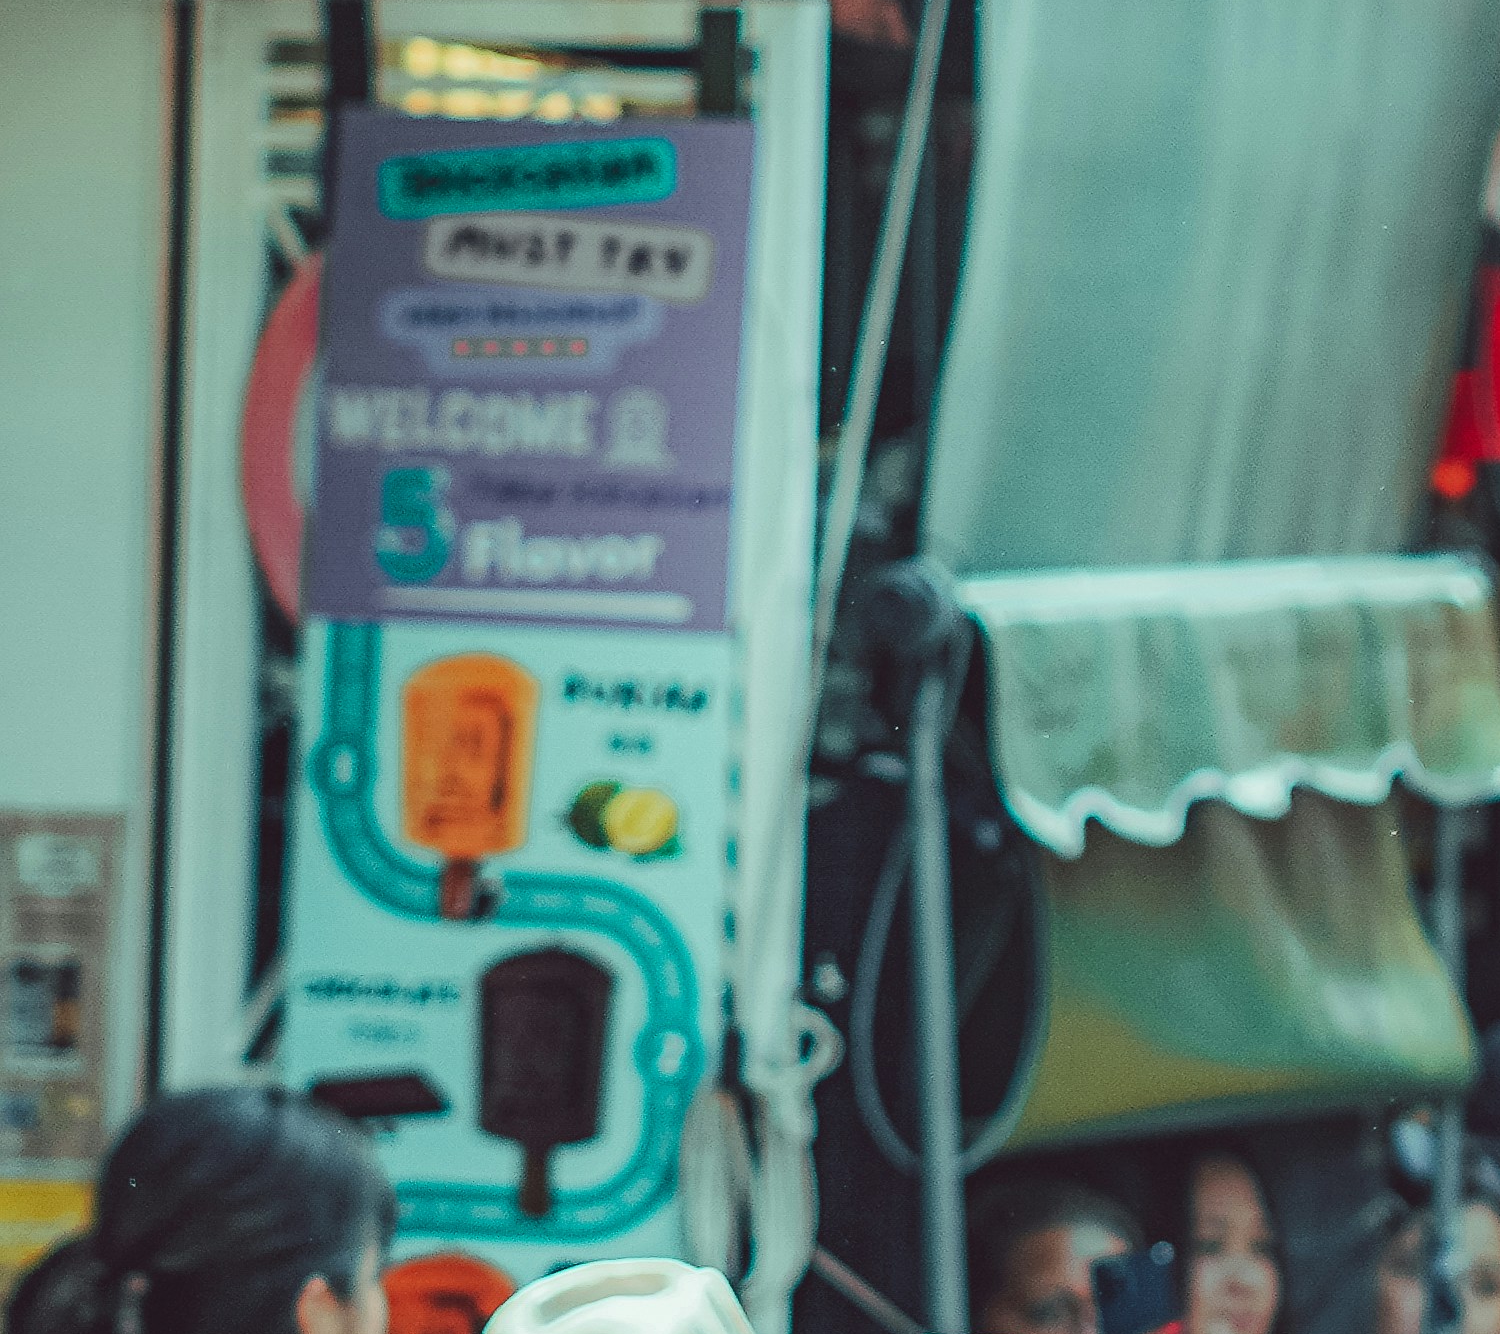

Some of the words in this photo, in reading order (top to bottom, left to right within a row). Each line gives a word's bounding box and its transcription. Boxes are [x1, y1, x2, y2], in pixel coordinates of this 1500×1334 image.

[327, 385, 598, 457] WELCOME
[376, 466, 454, 584] 5
[462, 515, 665, 583] Flavor
